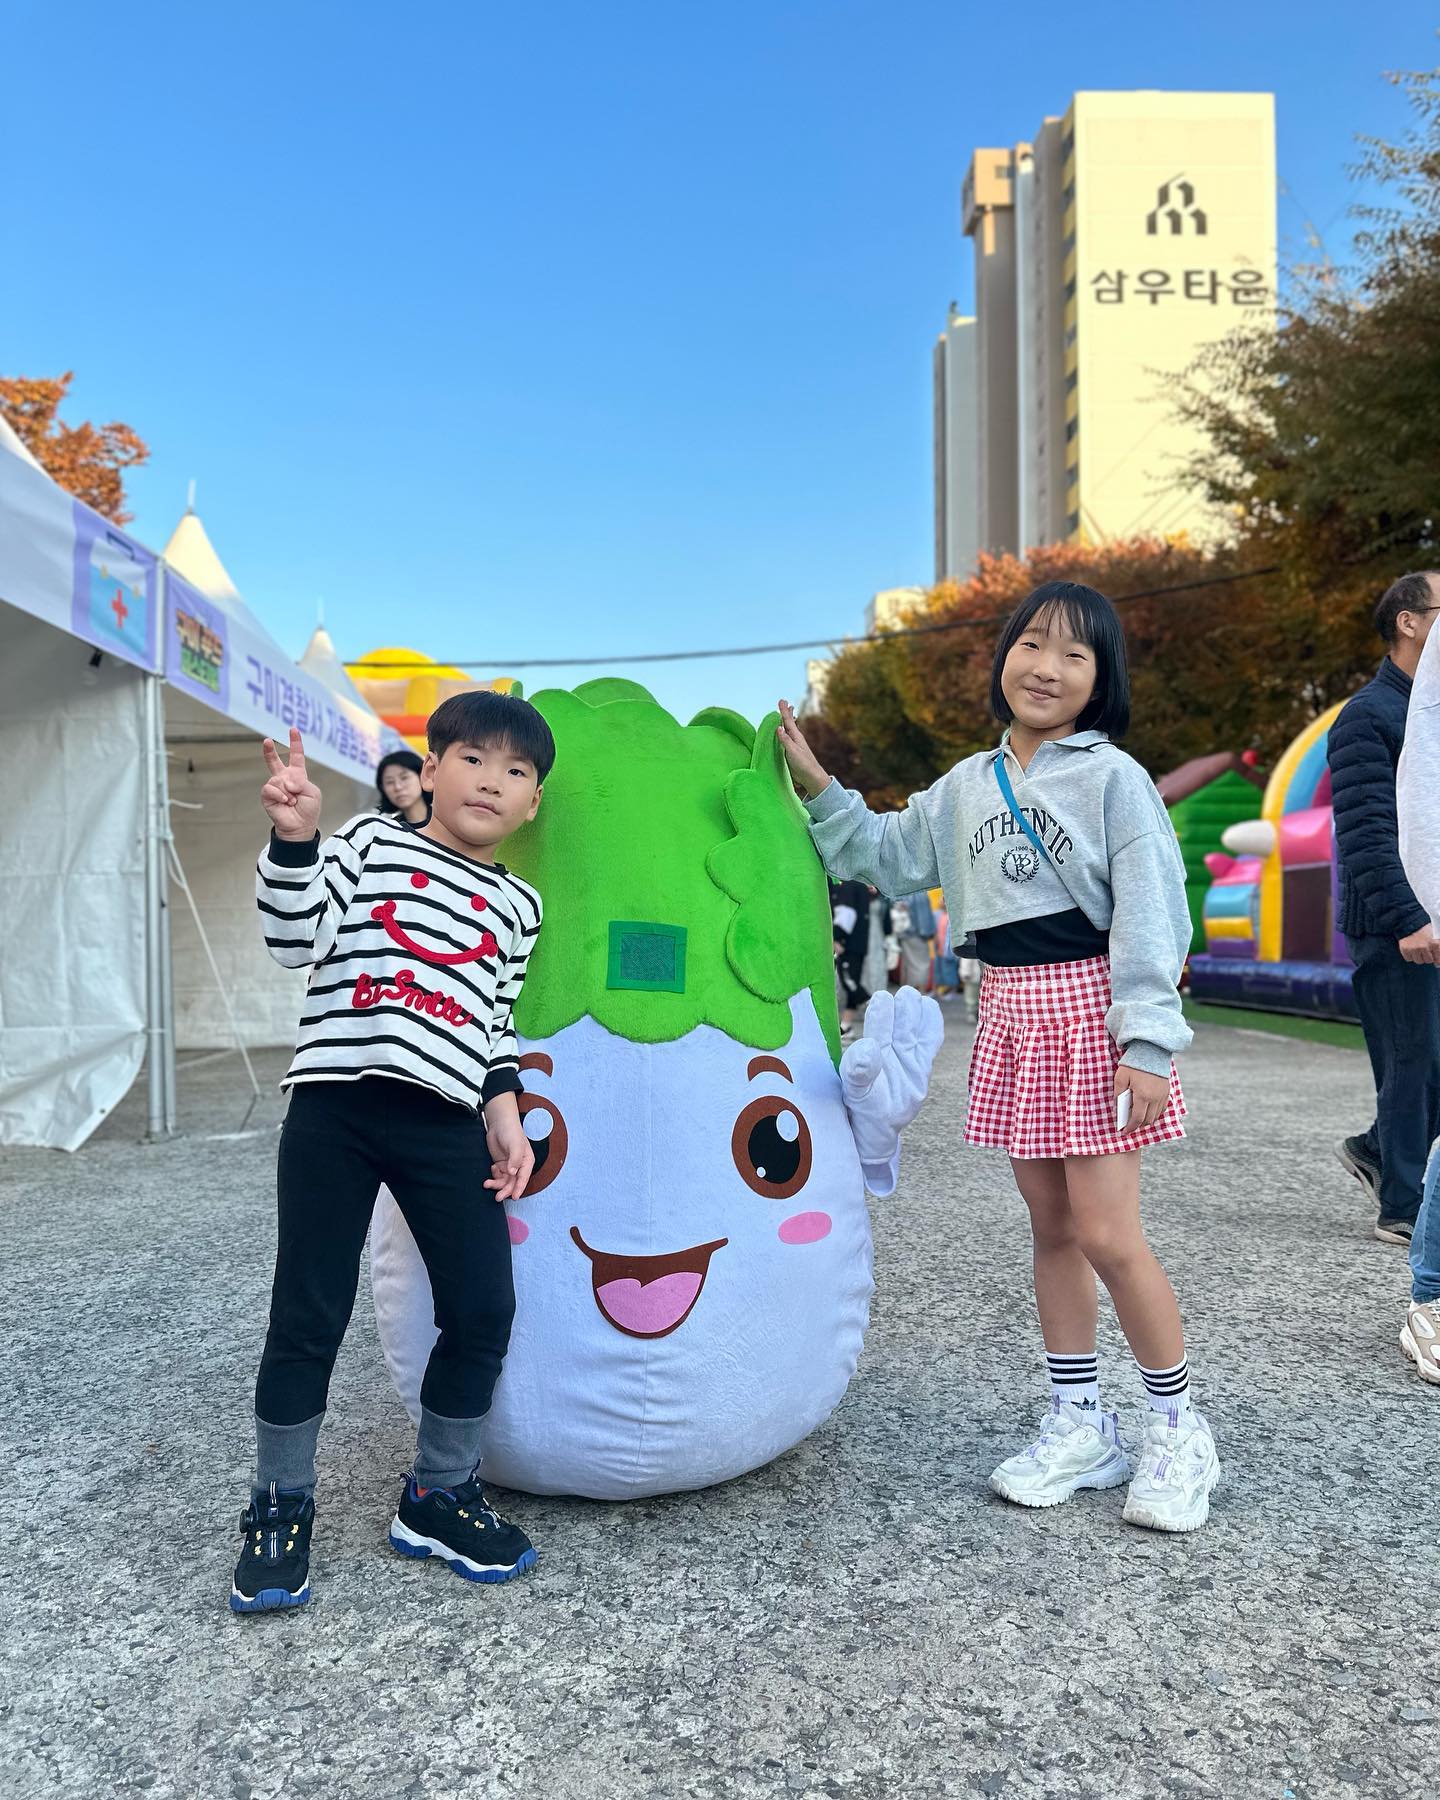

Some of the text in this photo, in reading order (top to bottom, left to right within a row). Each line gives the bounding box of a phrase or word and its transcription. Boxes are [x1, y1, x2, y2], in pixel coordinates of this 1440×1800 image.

[1090, 269, 1269, 306] 삼우타운
[246, 655, 322, 741] 구미경찰서
[968, 807, 1074, 869] AUTHENTIC
